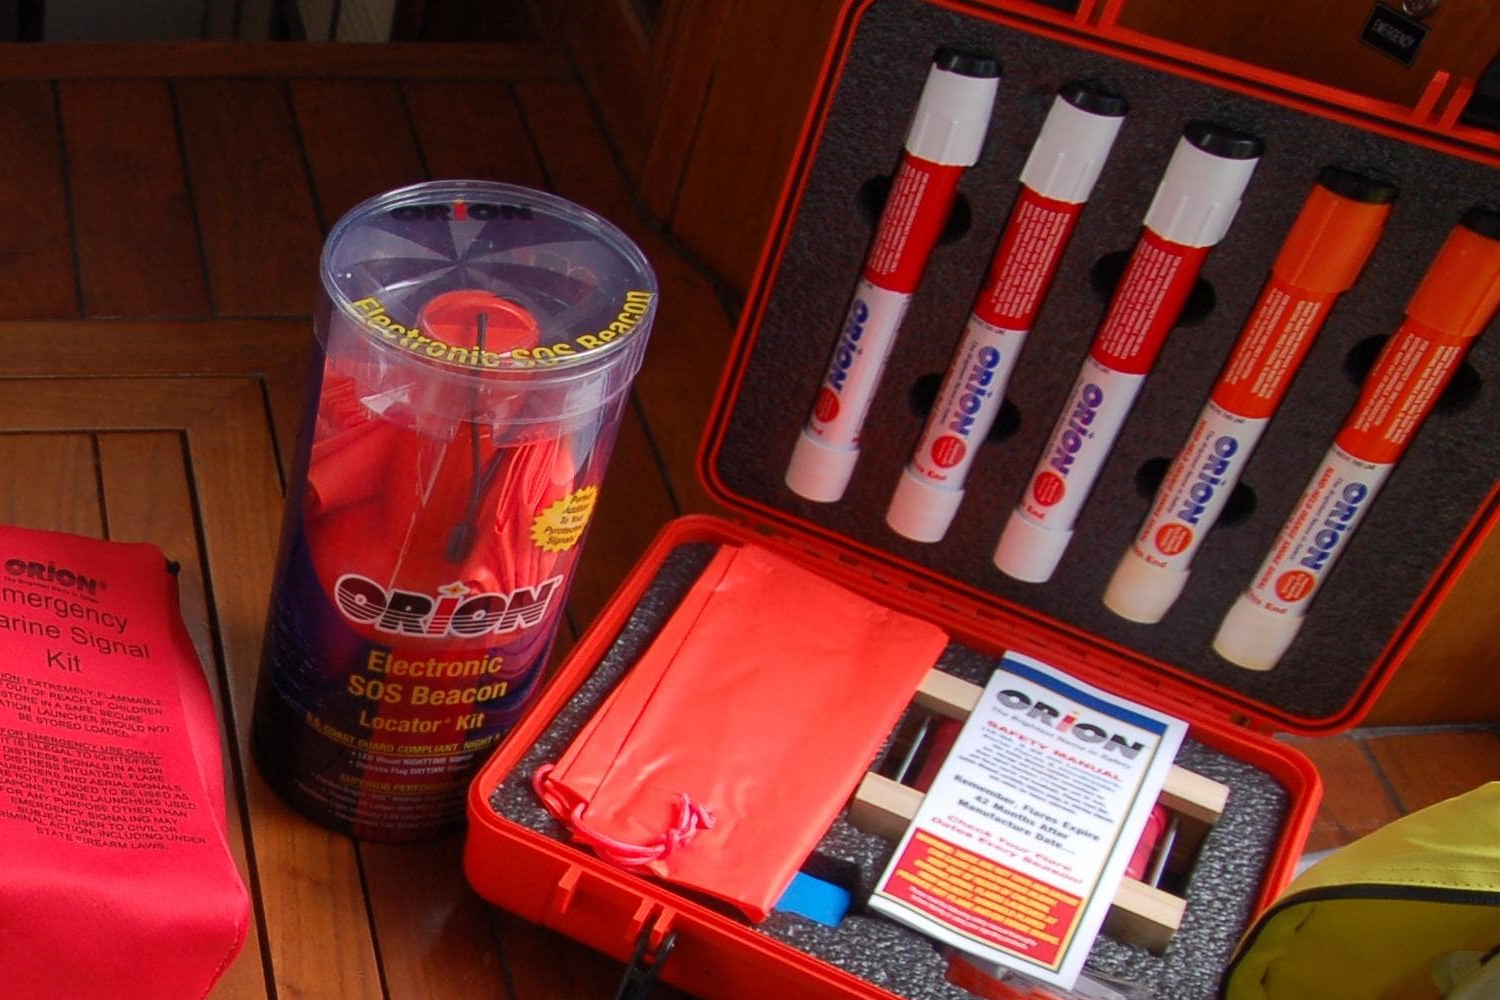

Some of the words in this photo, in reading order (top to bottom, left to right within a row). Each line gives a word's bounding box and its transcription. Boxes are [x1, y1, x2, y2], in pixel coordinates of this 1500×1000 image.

[351, 297, 499, 368] Electronic
[511, 343, 576, 368] SOS
[575, 291, 653, 353] Beacon
[953, 346, 1001, 436] ORION
[1051, 383, 1104, 477] ORION
[1177, 434, 1239, 528] ORION
[1300, 480, 1369, 572] ORION
[4, 558, 99, 594] ORION
[334, 574, 563, 638] ORION
[46, 649, 84, 673] Kit
[71, 626, 150, 659] Signal
[367, 649, 503, 679] Electronic
[348, 675, 404, 704] SOS
[410, 682, 507, 706] Beacon
[358, 710, 442, 733] Locator
[455, 711, 485, 731] Kit
[987, 720, 1048, 753] SAFETY
[1053, 749, 1123, 783] MANUAL
[996, 688, 1146, 760] ORION
